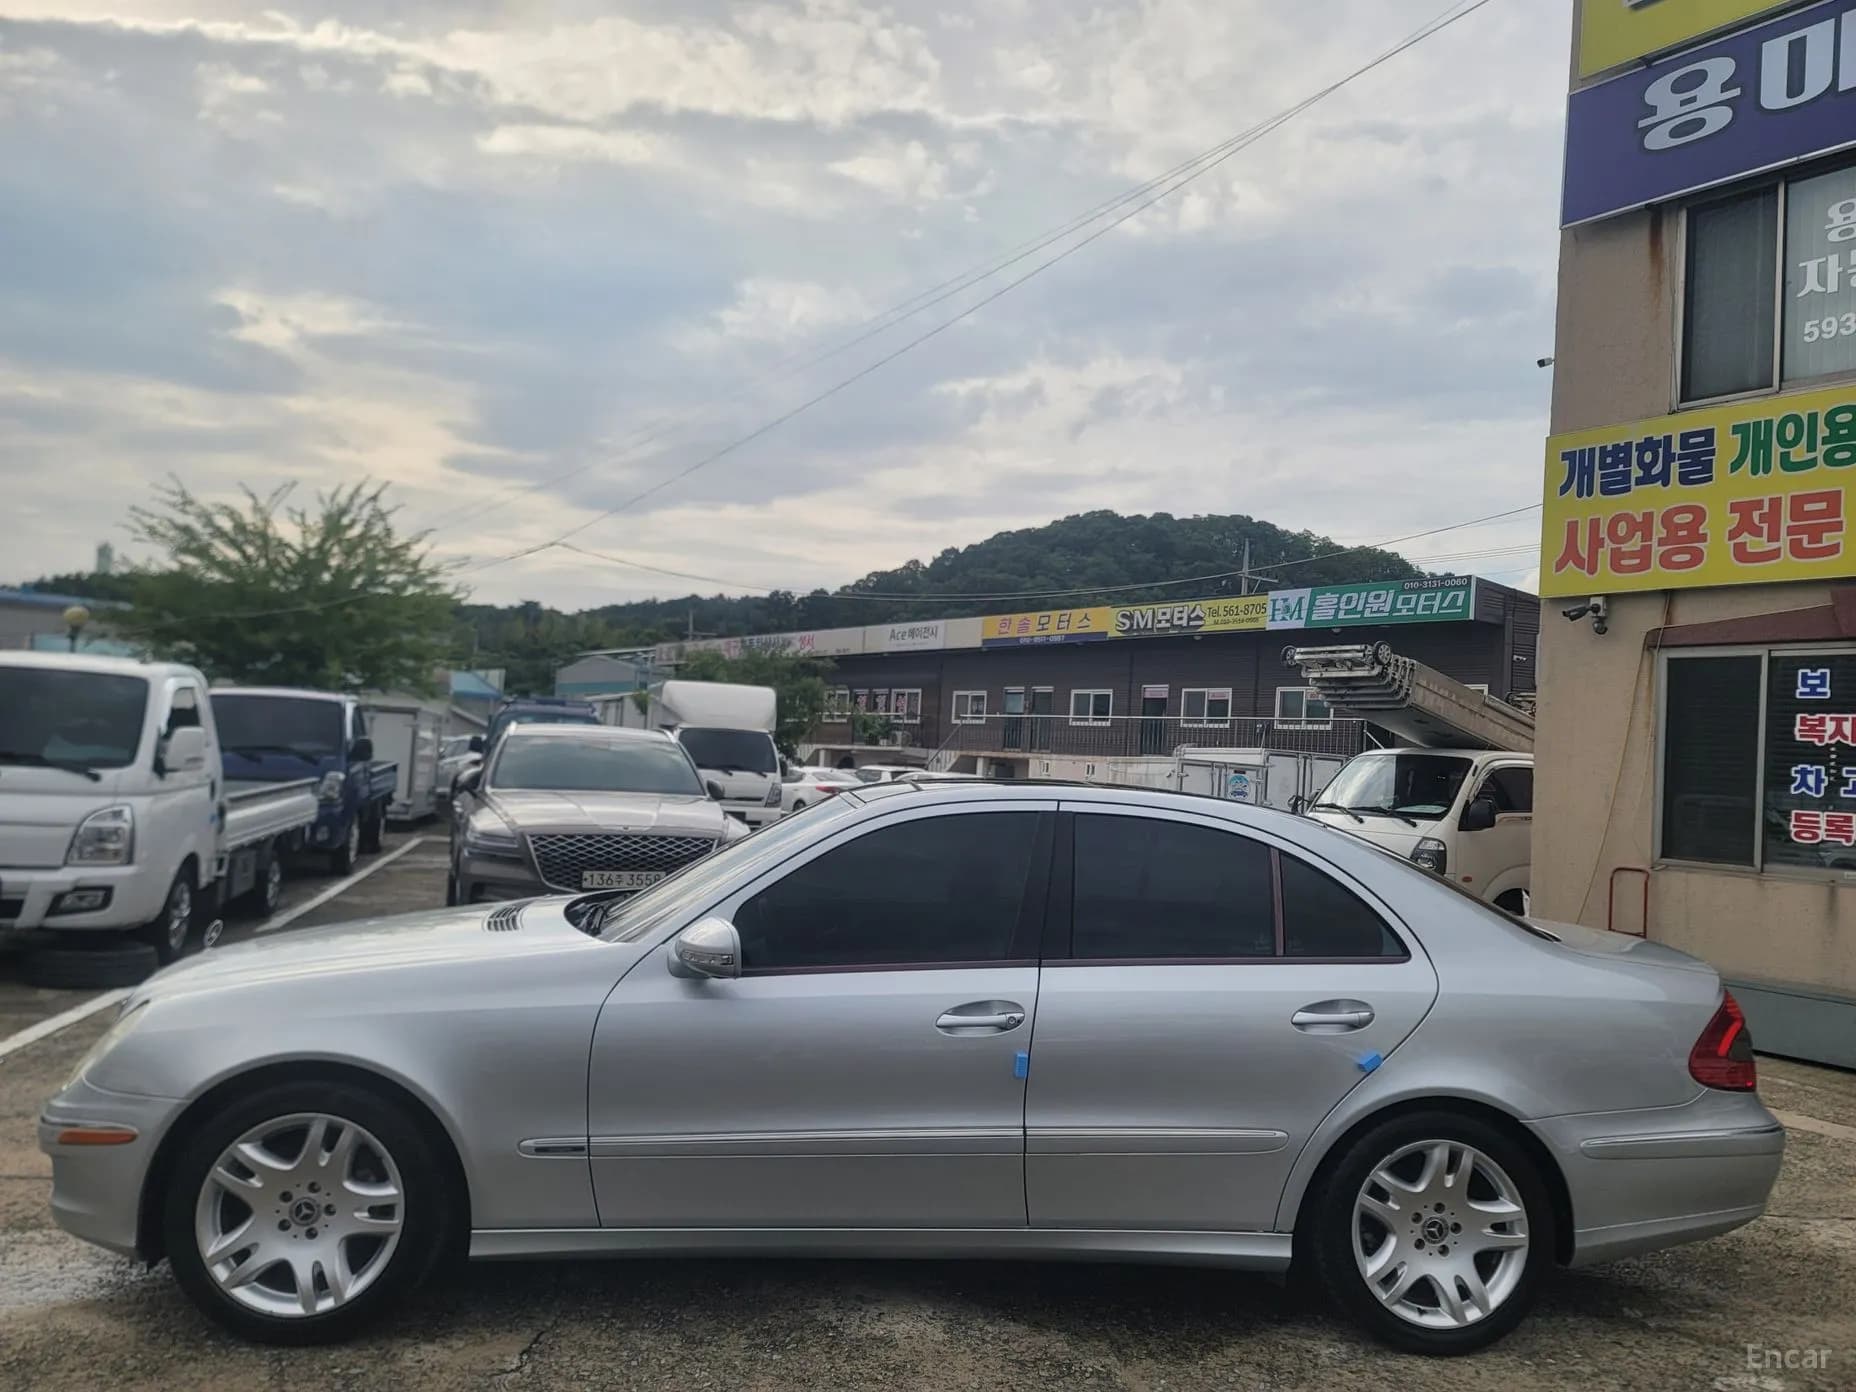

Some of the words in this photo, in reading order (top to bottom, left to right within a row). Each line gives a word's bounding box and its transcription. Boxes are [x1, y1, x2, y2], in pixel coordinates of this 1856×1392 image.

[1559, 427, 1717, 499] 개별화물
[1730, 404, 1856, 476] 개인용
[1554, 503, 1709, 576] 사업용
[1727, 489, 1844, 564] 전문
[1796, 669, 1831, 699] 보
